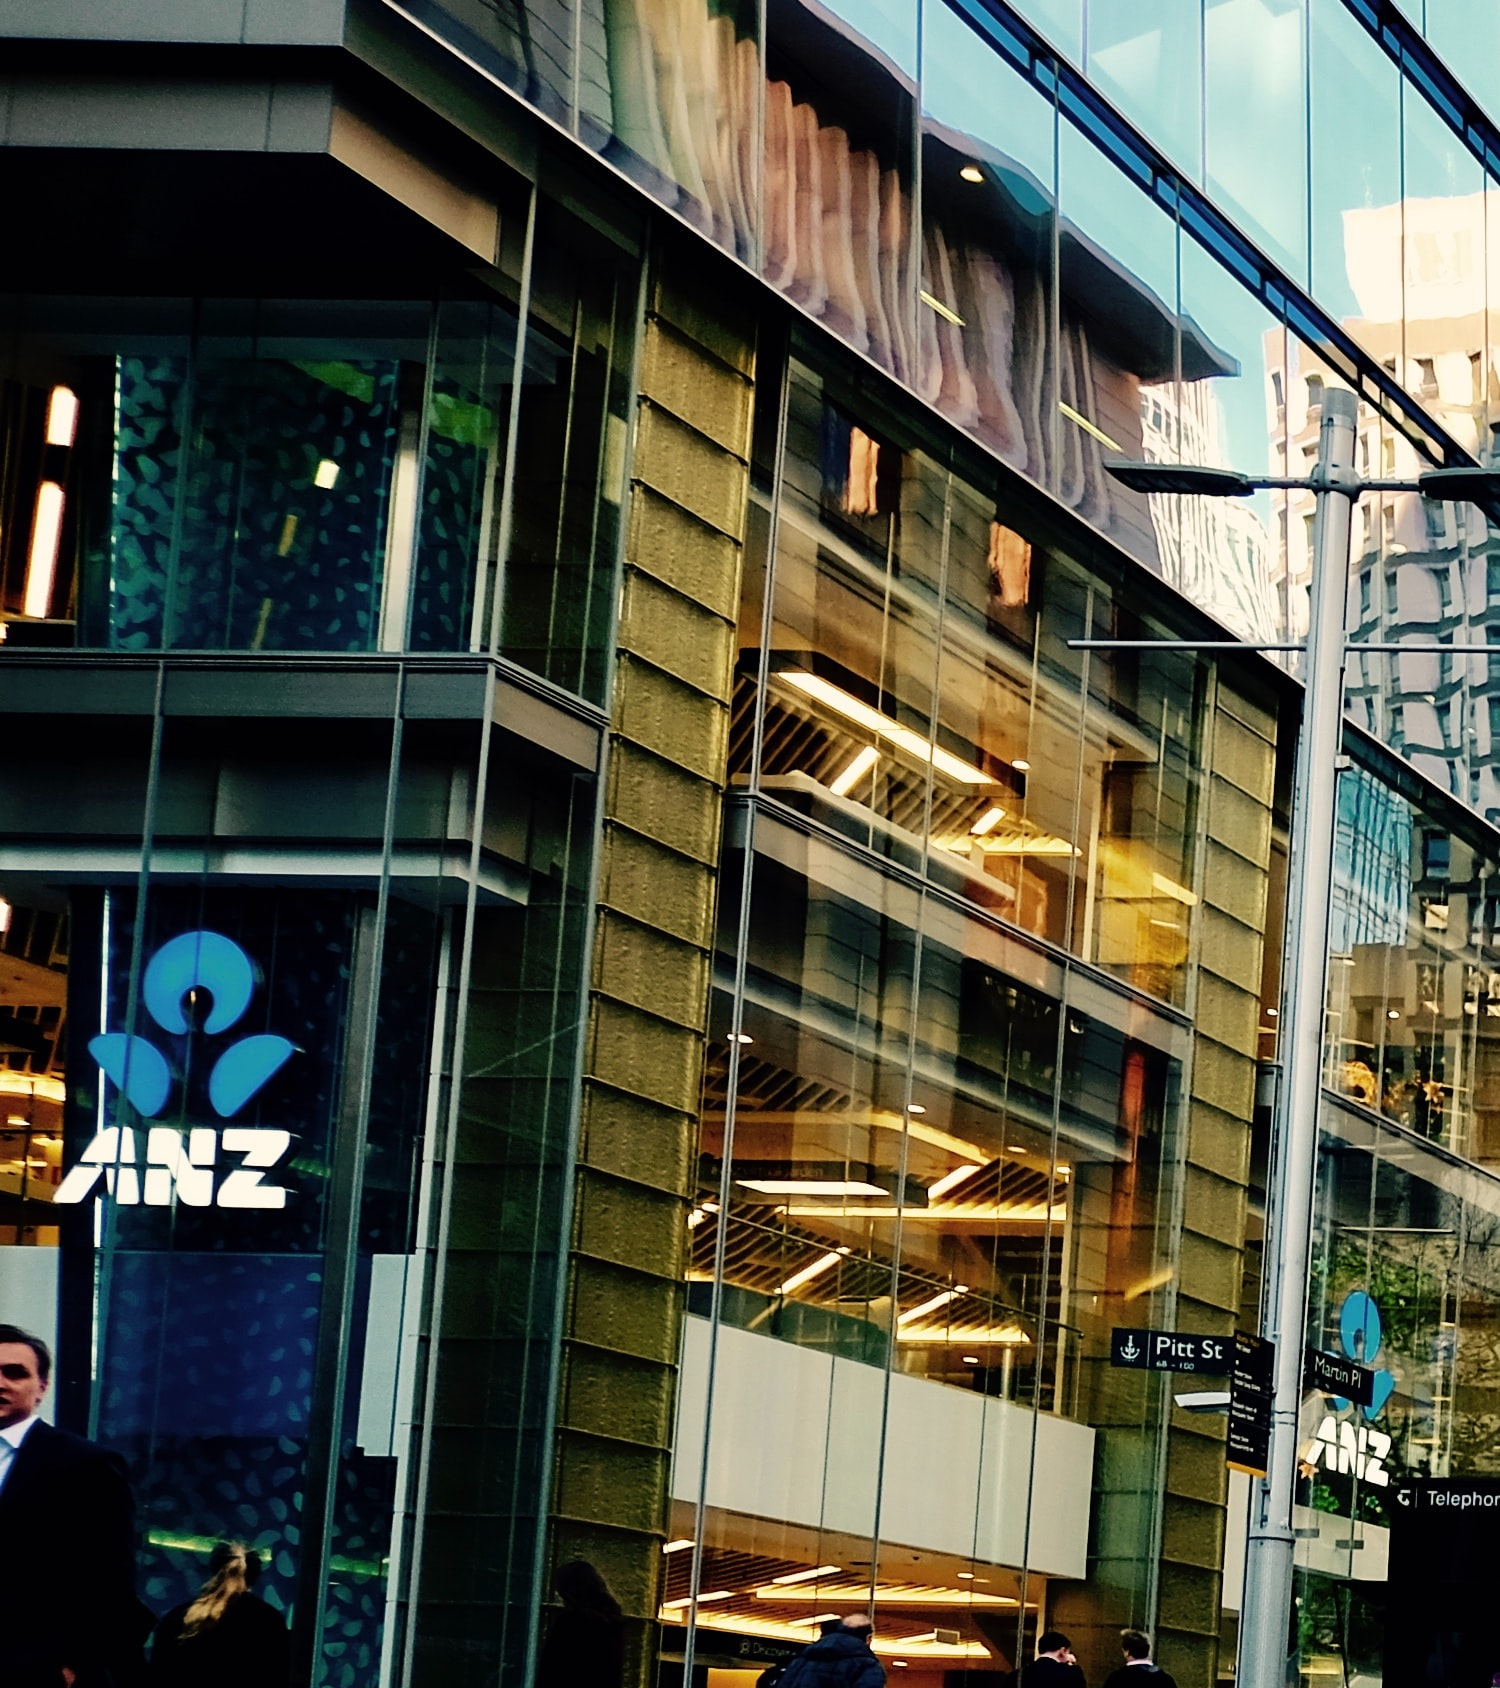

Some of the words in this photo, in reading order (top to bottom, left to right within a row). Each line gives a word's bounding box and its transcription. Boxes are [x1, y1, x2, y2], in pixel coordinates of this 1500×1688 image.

[53, 1126, 291, 1209] ANZ
[1156, 1336, 1195, 1358] Pitt
[1201, 1339, 1223, 1360] St
[1314, 1355, 1349, 1384] Martin
[1351, 1369, 1362, 1389] Pl
[1305, 1416, 1392, 1487] ANZ
